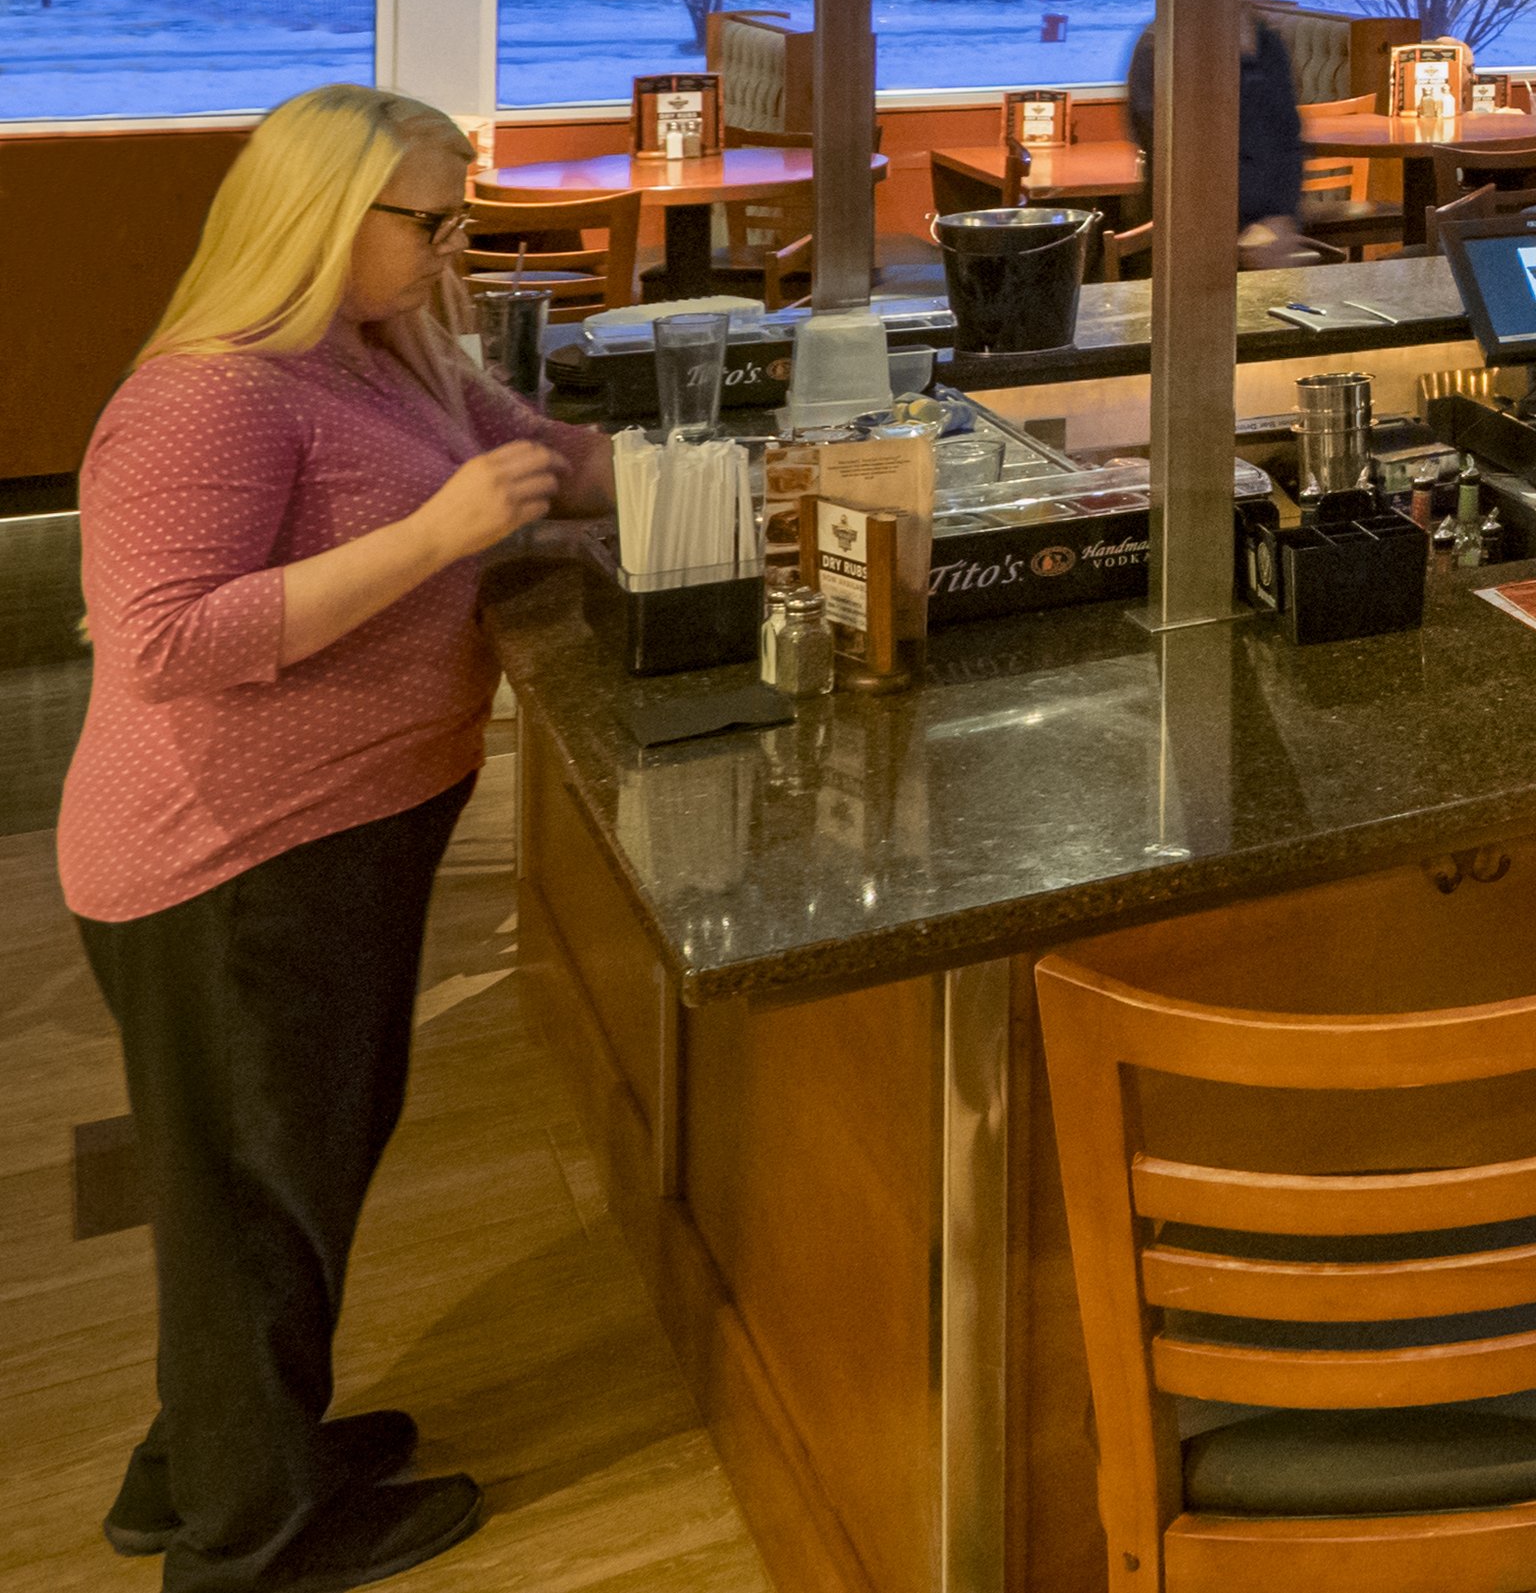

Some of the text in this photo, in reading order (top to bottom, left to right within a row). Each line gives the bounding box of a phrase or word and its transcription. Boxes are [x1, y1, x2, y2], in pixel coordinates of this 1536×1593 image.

[687, 362, 762, 387] Tio's
[1082, 536, 1149, 559] Handma
[822, 554, 867, 579] DRY RUBS
[928, 554, 1024, 596] Tito's
